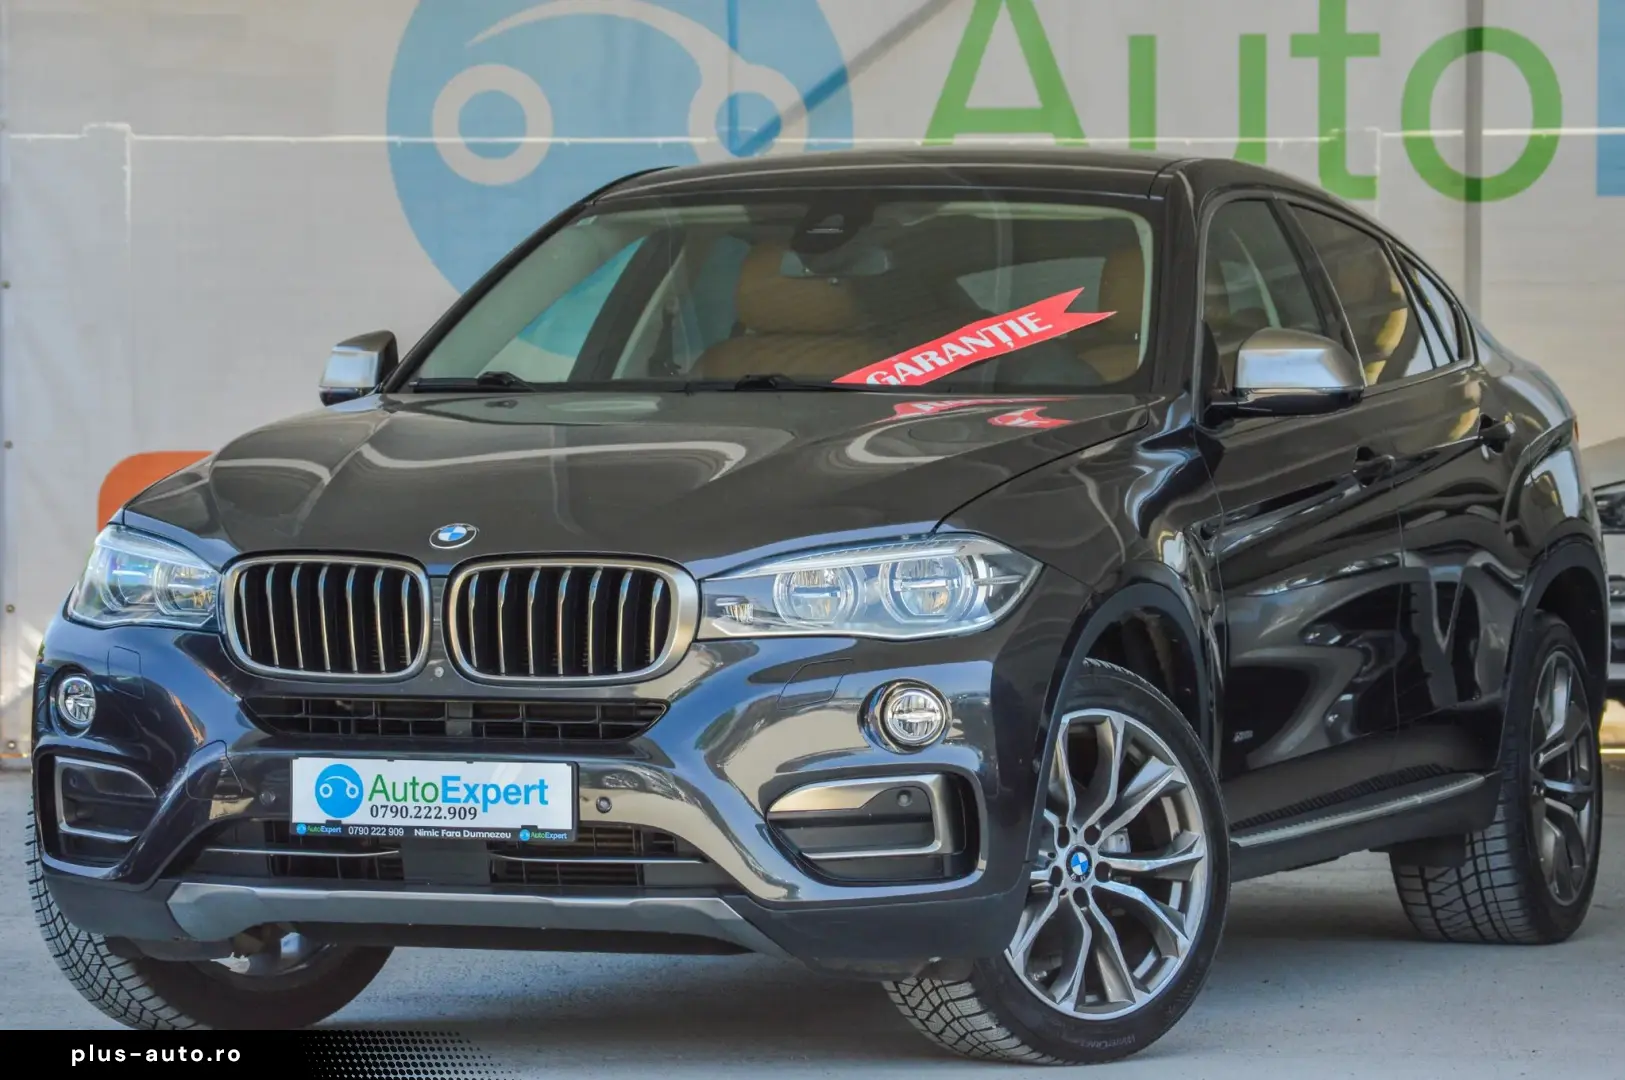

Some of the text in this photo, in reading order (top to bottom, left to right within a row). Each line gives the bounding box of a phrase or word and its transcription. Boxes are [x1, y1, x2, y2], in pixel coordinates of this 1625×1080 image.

[920, 0, 1625, 202] Auto
[368, 773, 549, 813] AutoExpert
[369, 804, 478, 821] 0790.222.909
[307, 825, 342, 835] AutoExpert
[348, 826, 512, 839] 0790 222 909 Nimic Fara Dumnezeu
[530, 831, 568, 840] AutoExpert
